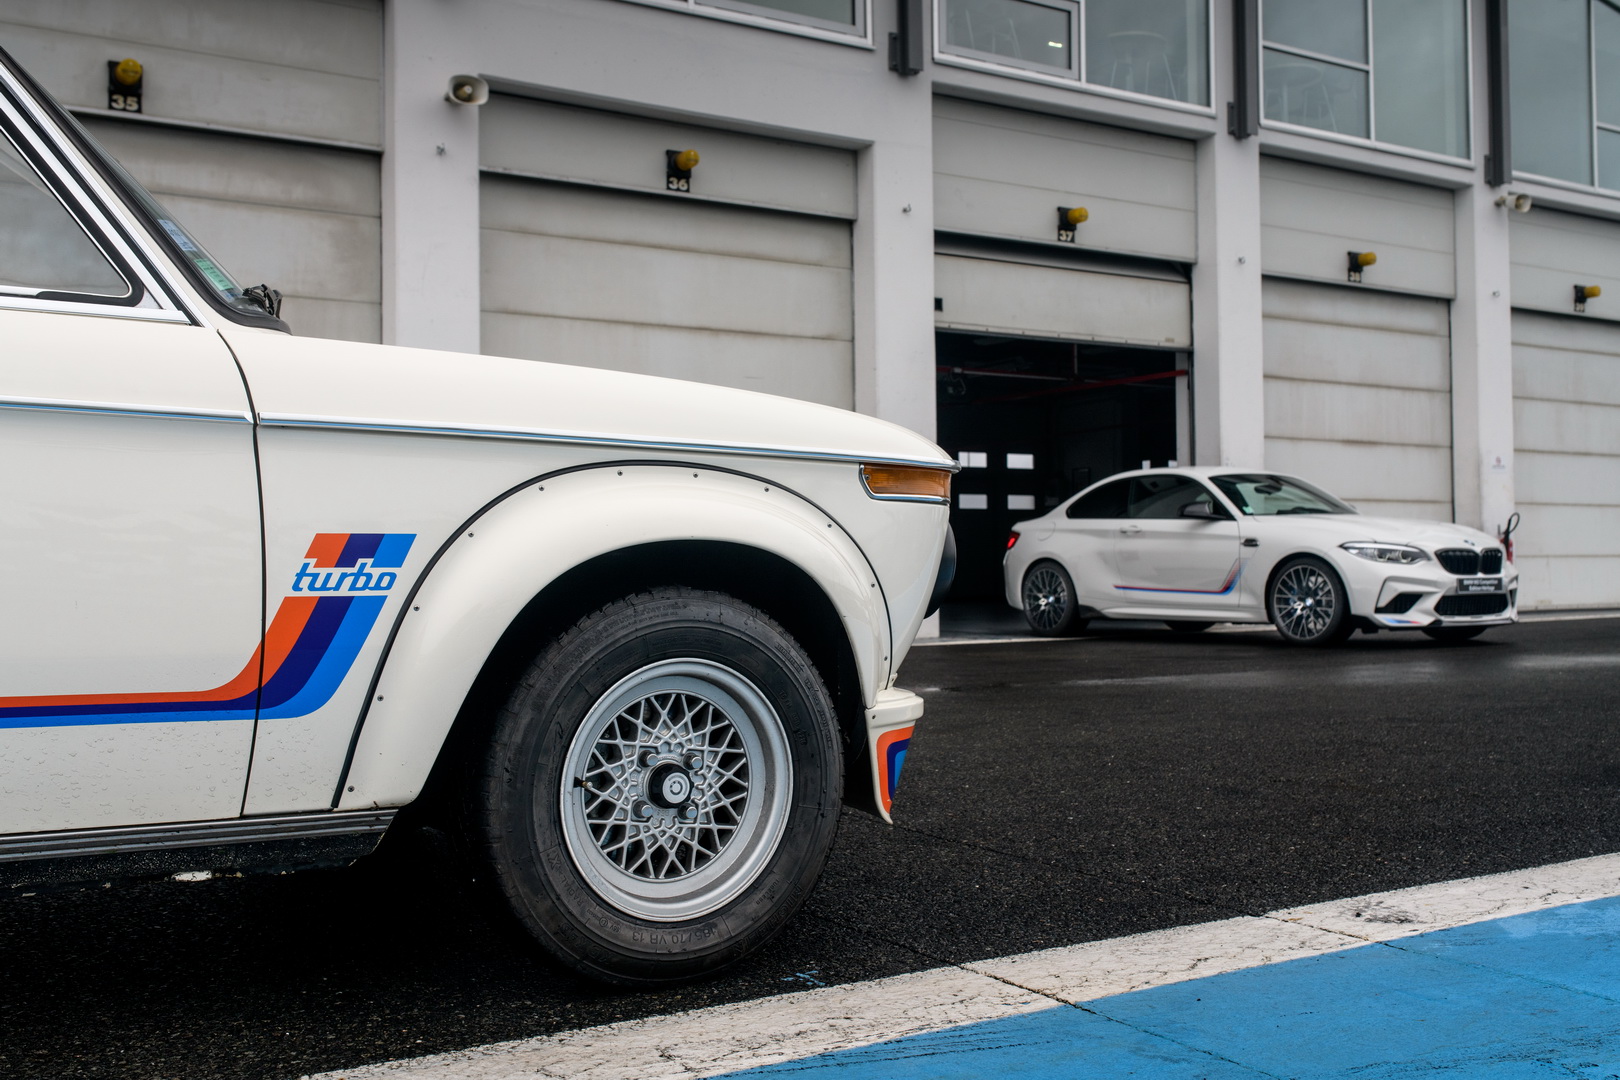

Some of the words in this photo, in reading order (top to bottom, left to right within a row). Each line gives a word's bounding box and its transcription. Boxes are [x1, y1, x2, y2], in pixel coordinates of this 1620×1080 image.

[111, 94, 139, 111] 35
[669, 177, 688, 191] 36
[1059, 230, 1074, 242] 37
[292, 562, 398, 592] turbo
[733, 885, 804, 954] MICHELIN
[632, 931, 645, 943] 13
[650, 933, 667, 945] VR
[672, 927, 718, 944] 185/70
